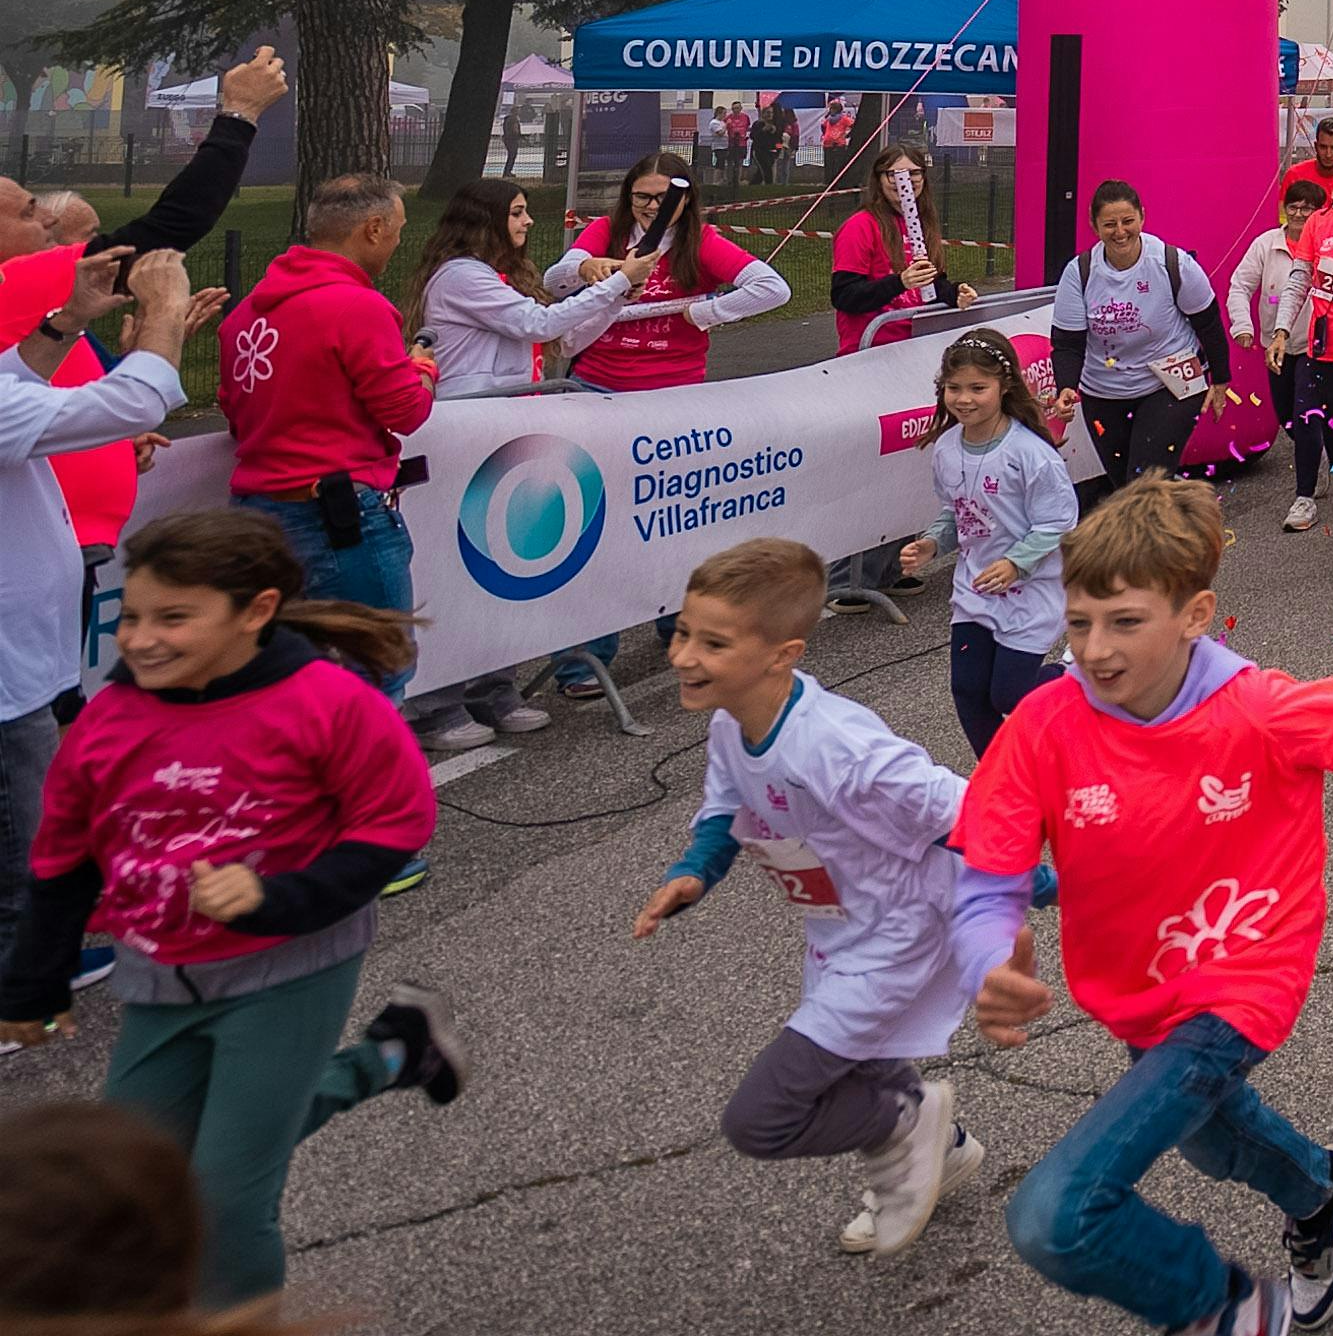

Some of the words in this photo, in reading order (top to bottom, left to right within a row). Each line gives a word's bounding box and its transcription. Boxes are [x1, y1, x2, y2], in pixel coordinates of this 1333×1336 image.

[623, 40, 782, 68] COMUNE
[793, 46, 820, 68] DI
[632, 427, 733, 466] Centro
[634, 446, 803, 506] Diagnostico
[633, 486, 786, 543] Villafranca
